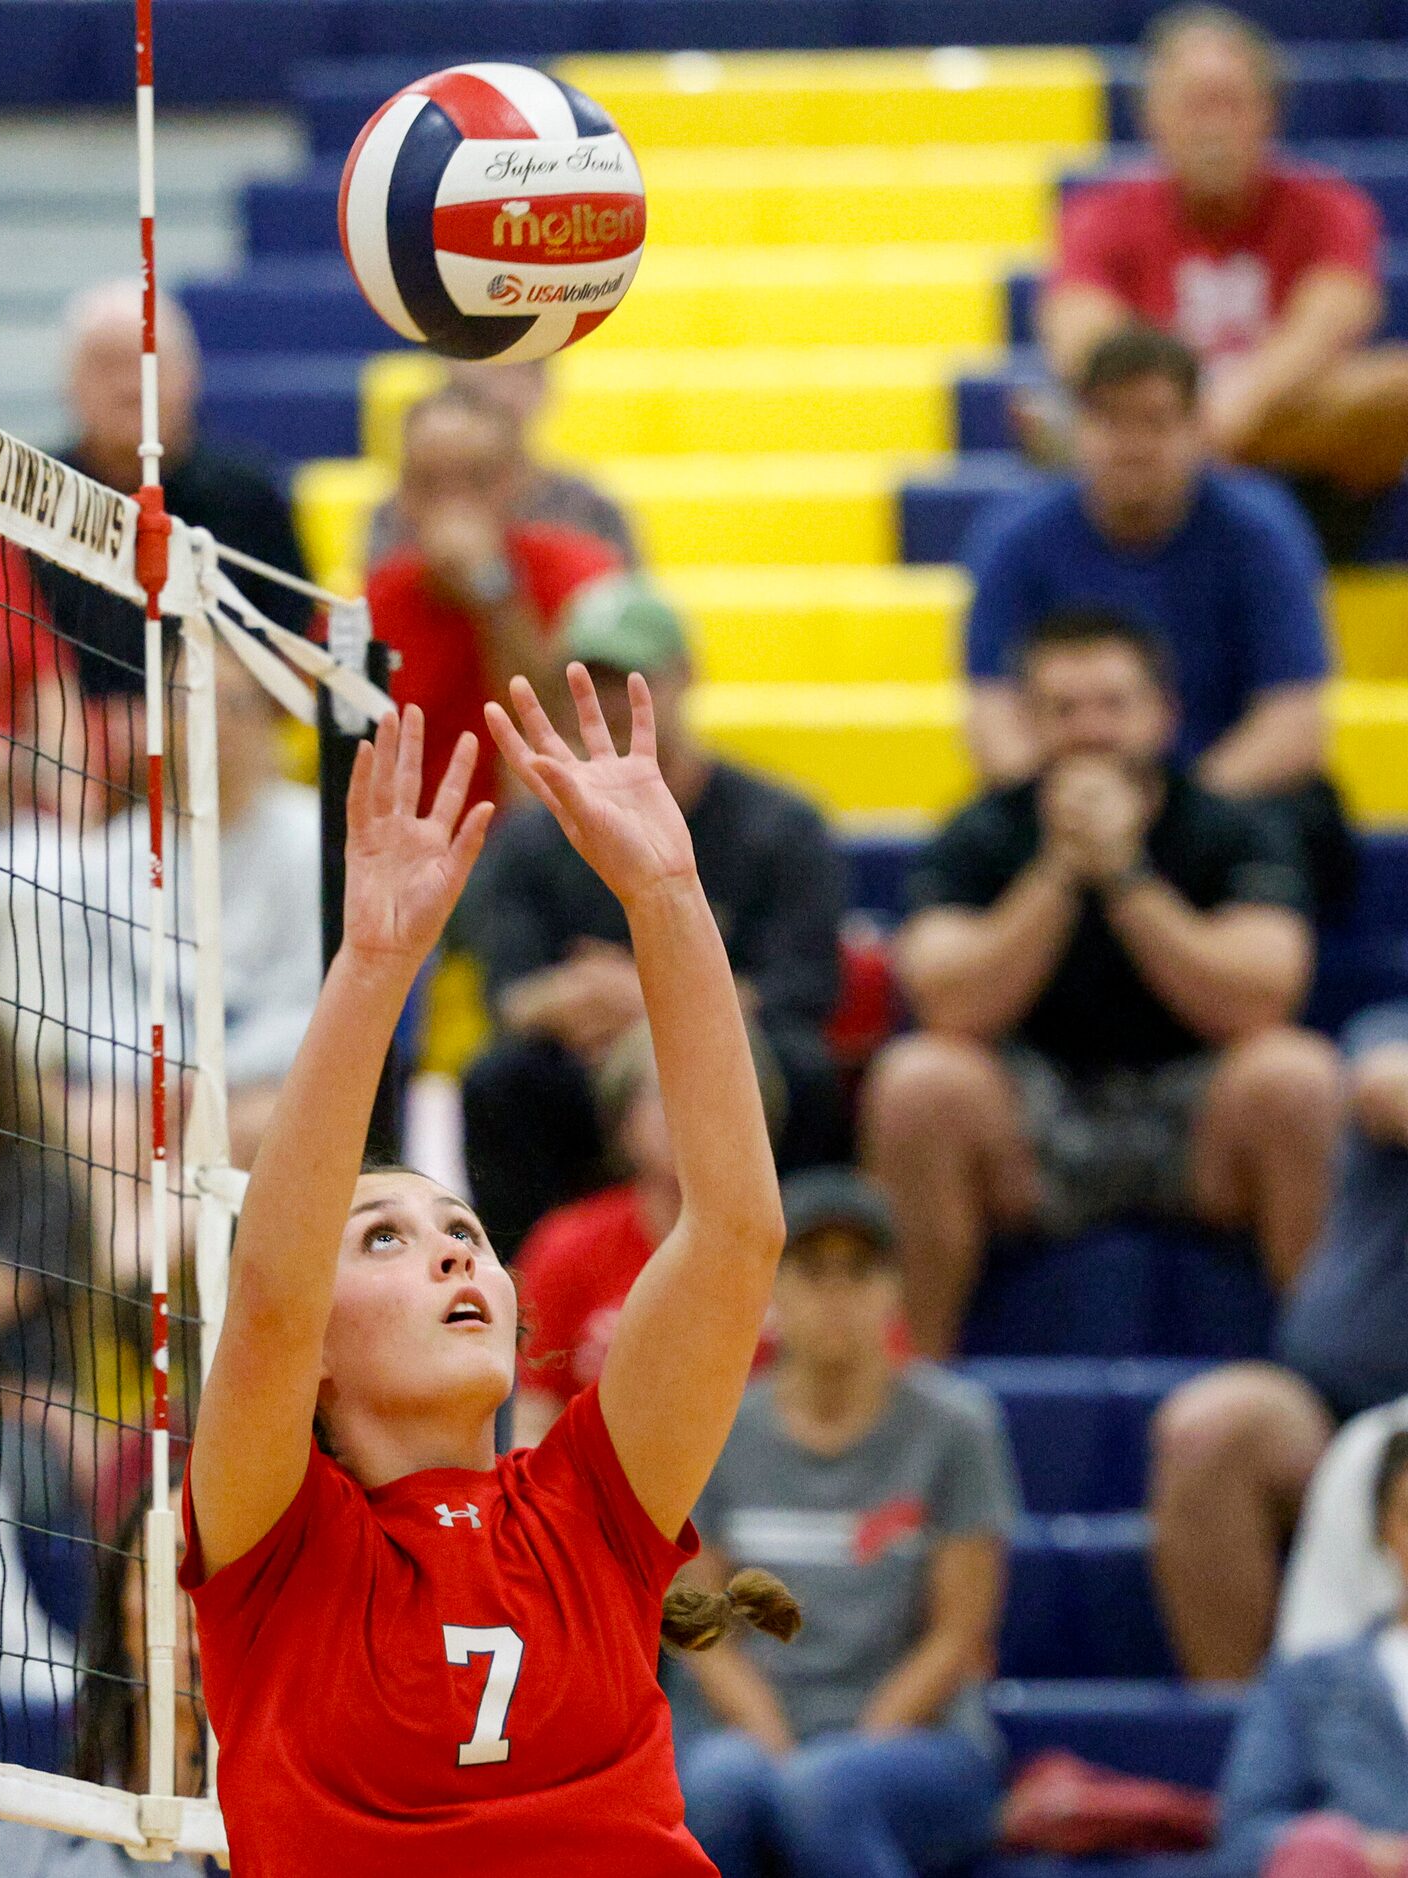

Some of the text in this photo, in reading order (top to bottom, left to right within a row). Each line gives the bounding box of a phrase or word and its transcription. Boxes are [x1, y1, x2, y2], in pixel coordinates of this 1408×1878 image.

[485, 145, 625, 186] Super Touch
[492, 200, 638, 247] molten
[70, 473, 126, 560] LIONS
[441, 1623, 525, 1768] 7
